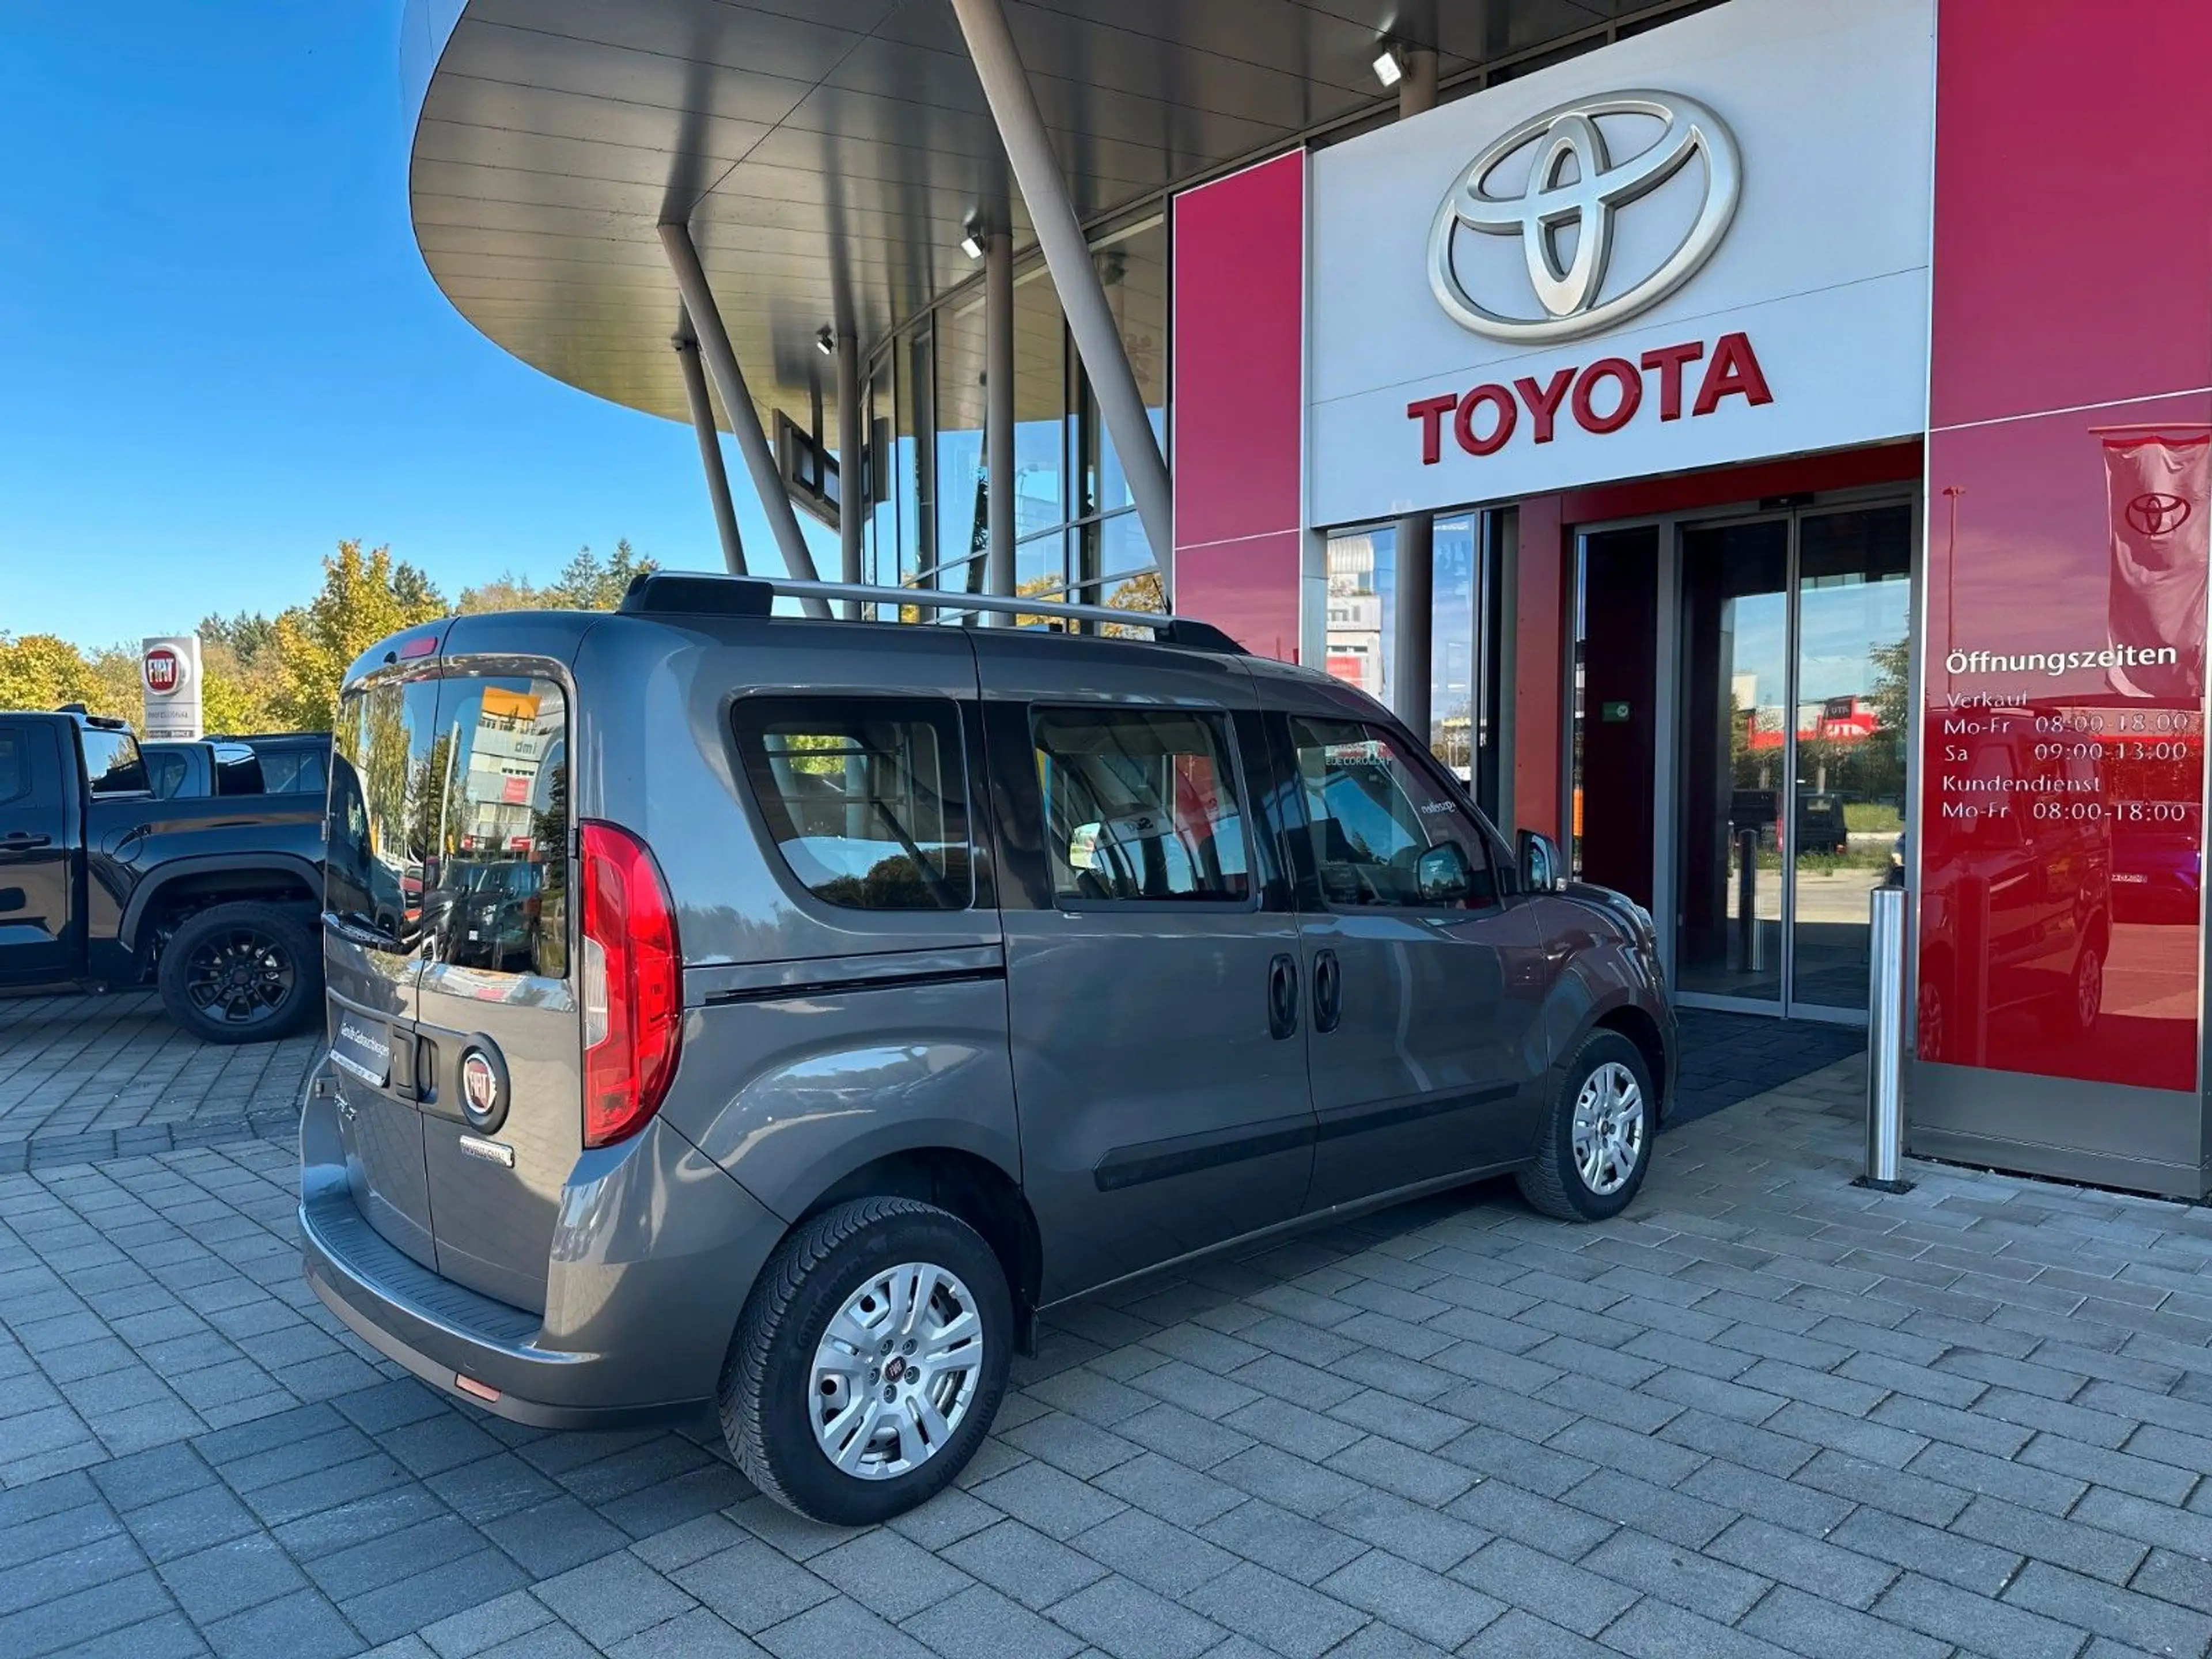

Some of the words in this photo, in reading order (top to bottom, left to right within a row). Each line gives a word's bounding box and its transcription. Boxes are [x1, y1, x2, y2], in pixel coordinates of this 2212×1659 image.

[1407, 331, 1774, 465] TOYOTA
[1945, 643, 2177, 676] Öffnungszeiten
[147, 658, 174, 683] FIAT
[1946, 690, 2029, 709] Verkauf
[1944, 717, 2012, 735] Mo-Fr
[1944, 745, 1969, 762] Sa
[2034, 742, 2188, 762] 09:00-13:00
[1942, 774, 2101, 792] Kundendienst
[1941, 801, 2009, 819] Mo-Fr
[2032, 802, 2186, 822] 08:00-18:00
